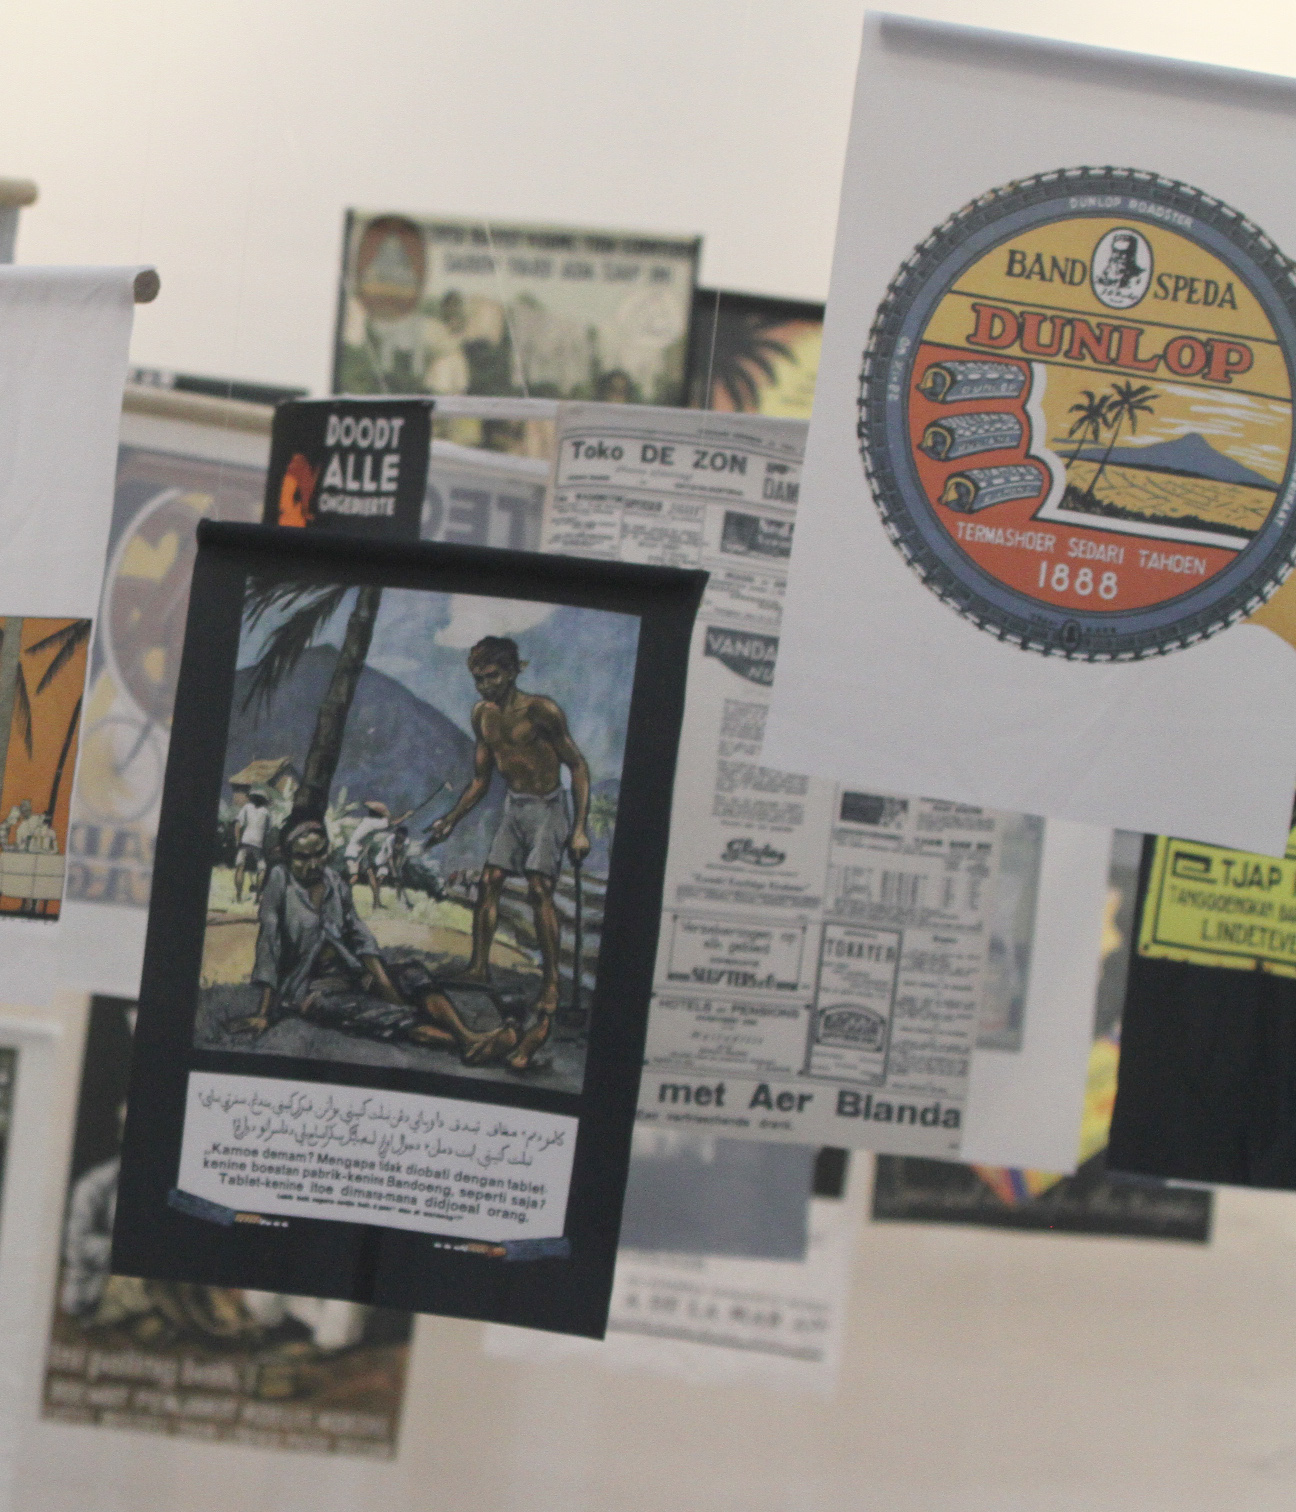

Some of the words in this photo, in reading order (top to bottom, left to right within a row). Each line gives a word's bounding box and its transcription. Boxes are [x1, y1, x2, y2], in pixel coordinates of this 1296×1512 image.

[1069, 195, 1122, 210] DUNLOP
[1128, 199, 1194, 229] ROADSTER
[1006, 248, 1087, 287] BAND
[1153, 272, 1239, 310] SPEDA
[966, 301, 1254, 385] DUNLOP
[325, 414, 404, 449] DOODT
[322, 452, 401, 493] ALLE
[572, 440, 624, 461] Toko
[640, 444, 675, 466] DE
[692, 449, 748, 476] ZON
[956, 521, 1057, 553] TERMASHOER
[1067, 537, 1125, 565] SEDARI
[1138, 548, 1206, 575] TAHOEN
[1037, 560, 1118, 601] 1888
[1221, 857, 1283, 892] TJAP
[658, 1082, 726, 1107] met
[748, 1083, 814, 1113] Aer
[835, 1089, 963, 1130] Blanda
[203, 1157, 247, 1172] kenine
[459, 1187, 507, 1206] seperti
[317, 1152, 377, 1171] Mengapa
[406, 1163, 450, 1180] diobati
[454, 1170, 508, 1190] dengan
[219, 1172, 304, 1192] Tablet-kenine
[310, 1181, 334, 1195] itoe
[425, 1196, 480, 1216] didjoeal
